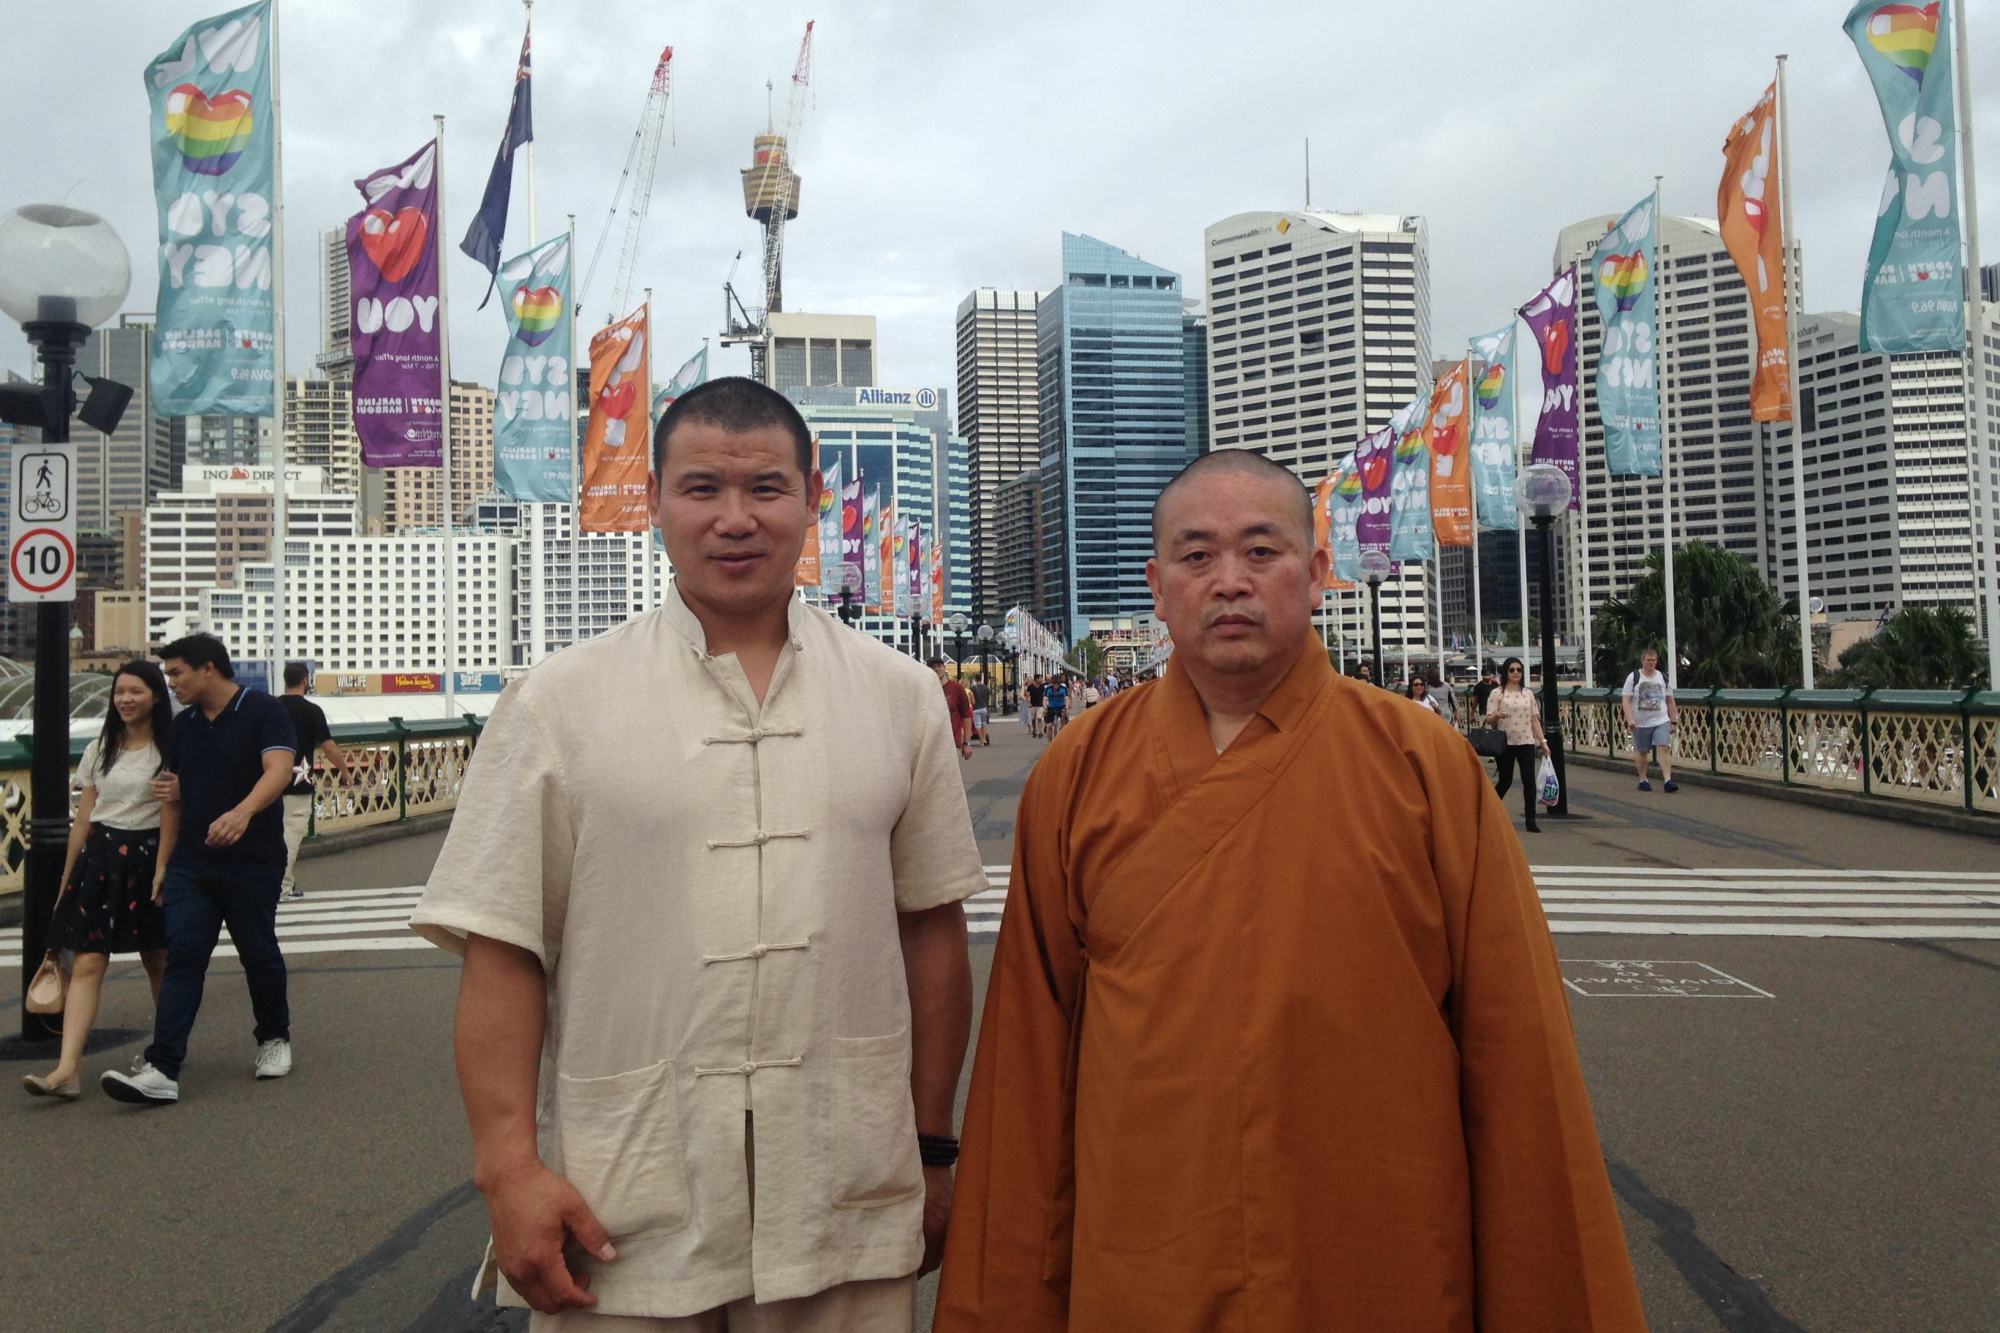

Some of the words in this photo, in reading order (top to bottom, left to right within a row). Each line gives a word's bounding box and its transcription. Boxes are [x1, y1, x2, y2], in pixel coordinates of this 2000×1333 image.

[859, 389, 911, 405] Allianz
[202, 470, 228, 480] ING
[252, 471, 302, 481] DIRCT
[23, 546, 61, 574] 10
